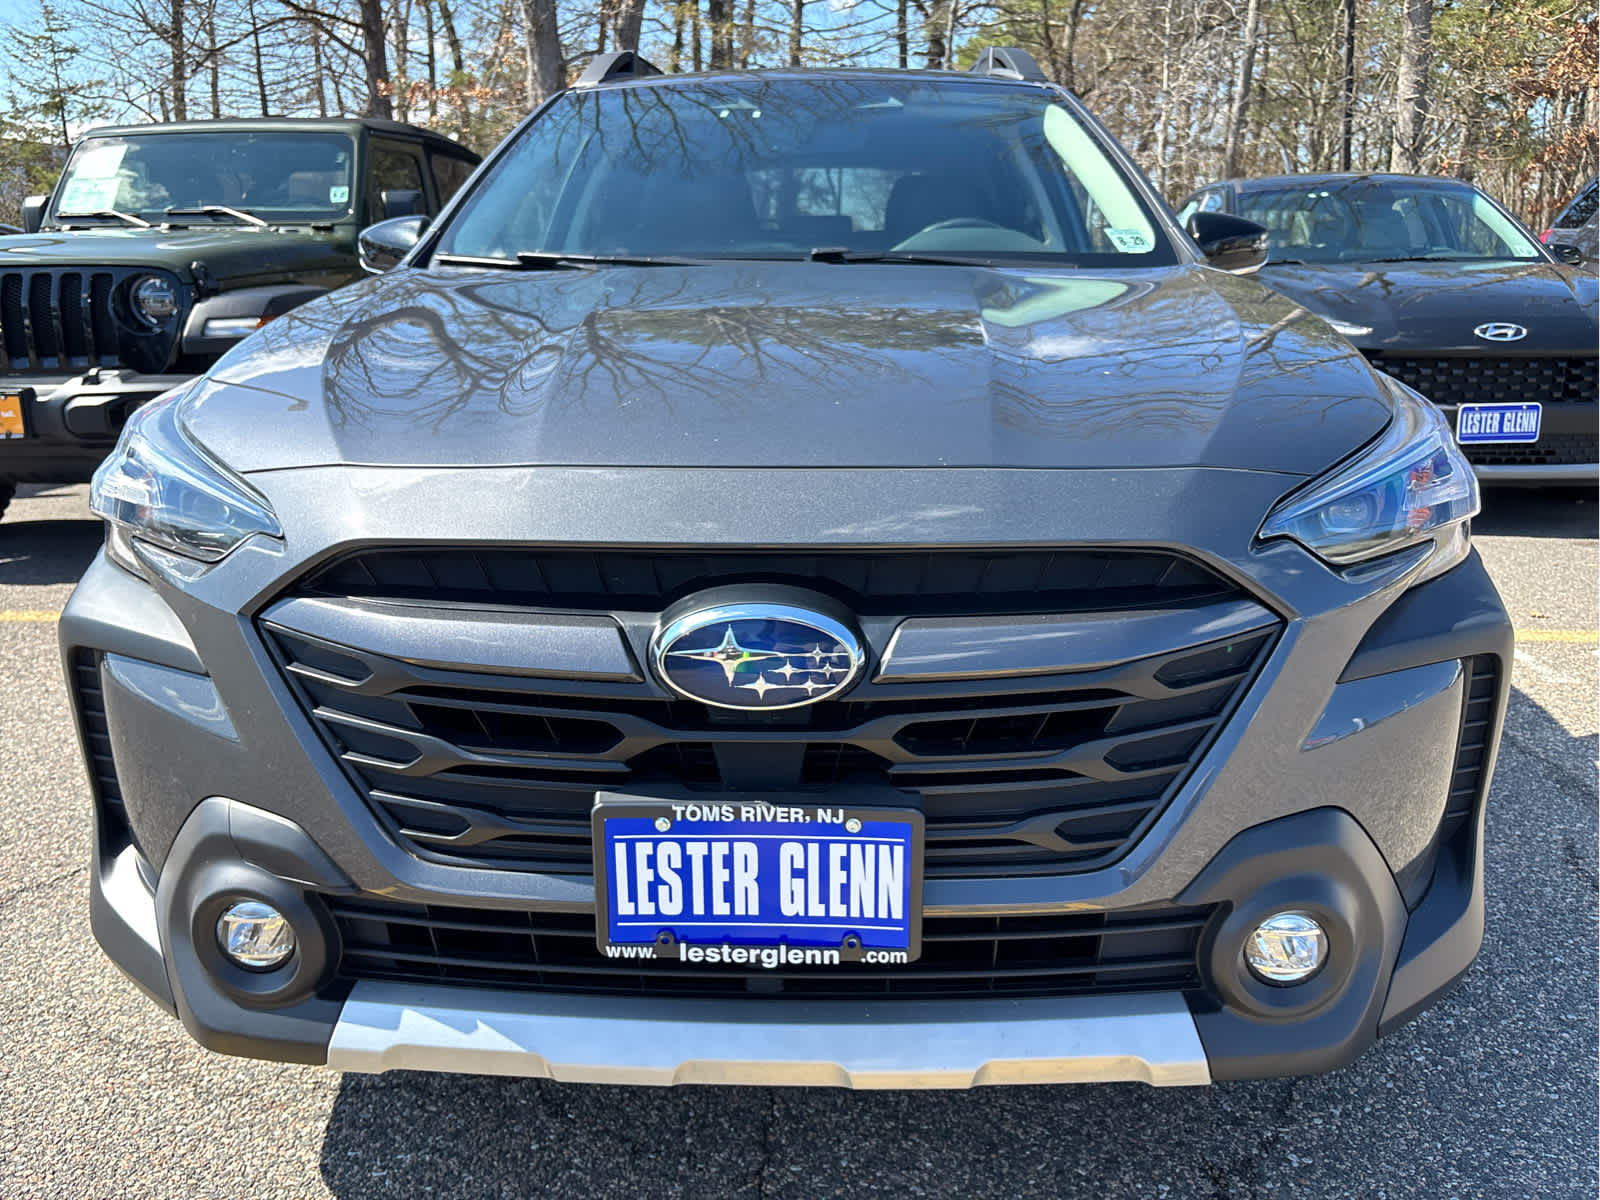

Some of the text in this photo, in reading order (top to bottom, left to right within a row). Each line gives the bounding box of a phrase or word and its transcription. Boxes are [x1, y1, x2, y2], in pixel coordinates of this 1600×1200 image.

[1461, 409, 1538, 434] LESTER GLENN
[672, 804, 844, 824] TOMS RIVER, NJ
[614, 841, 904, 919] LESTER GLENN
[605, 943, 908, 968] www. lesterglenn .com
